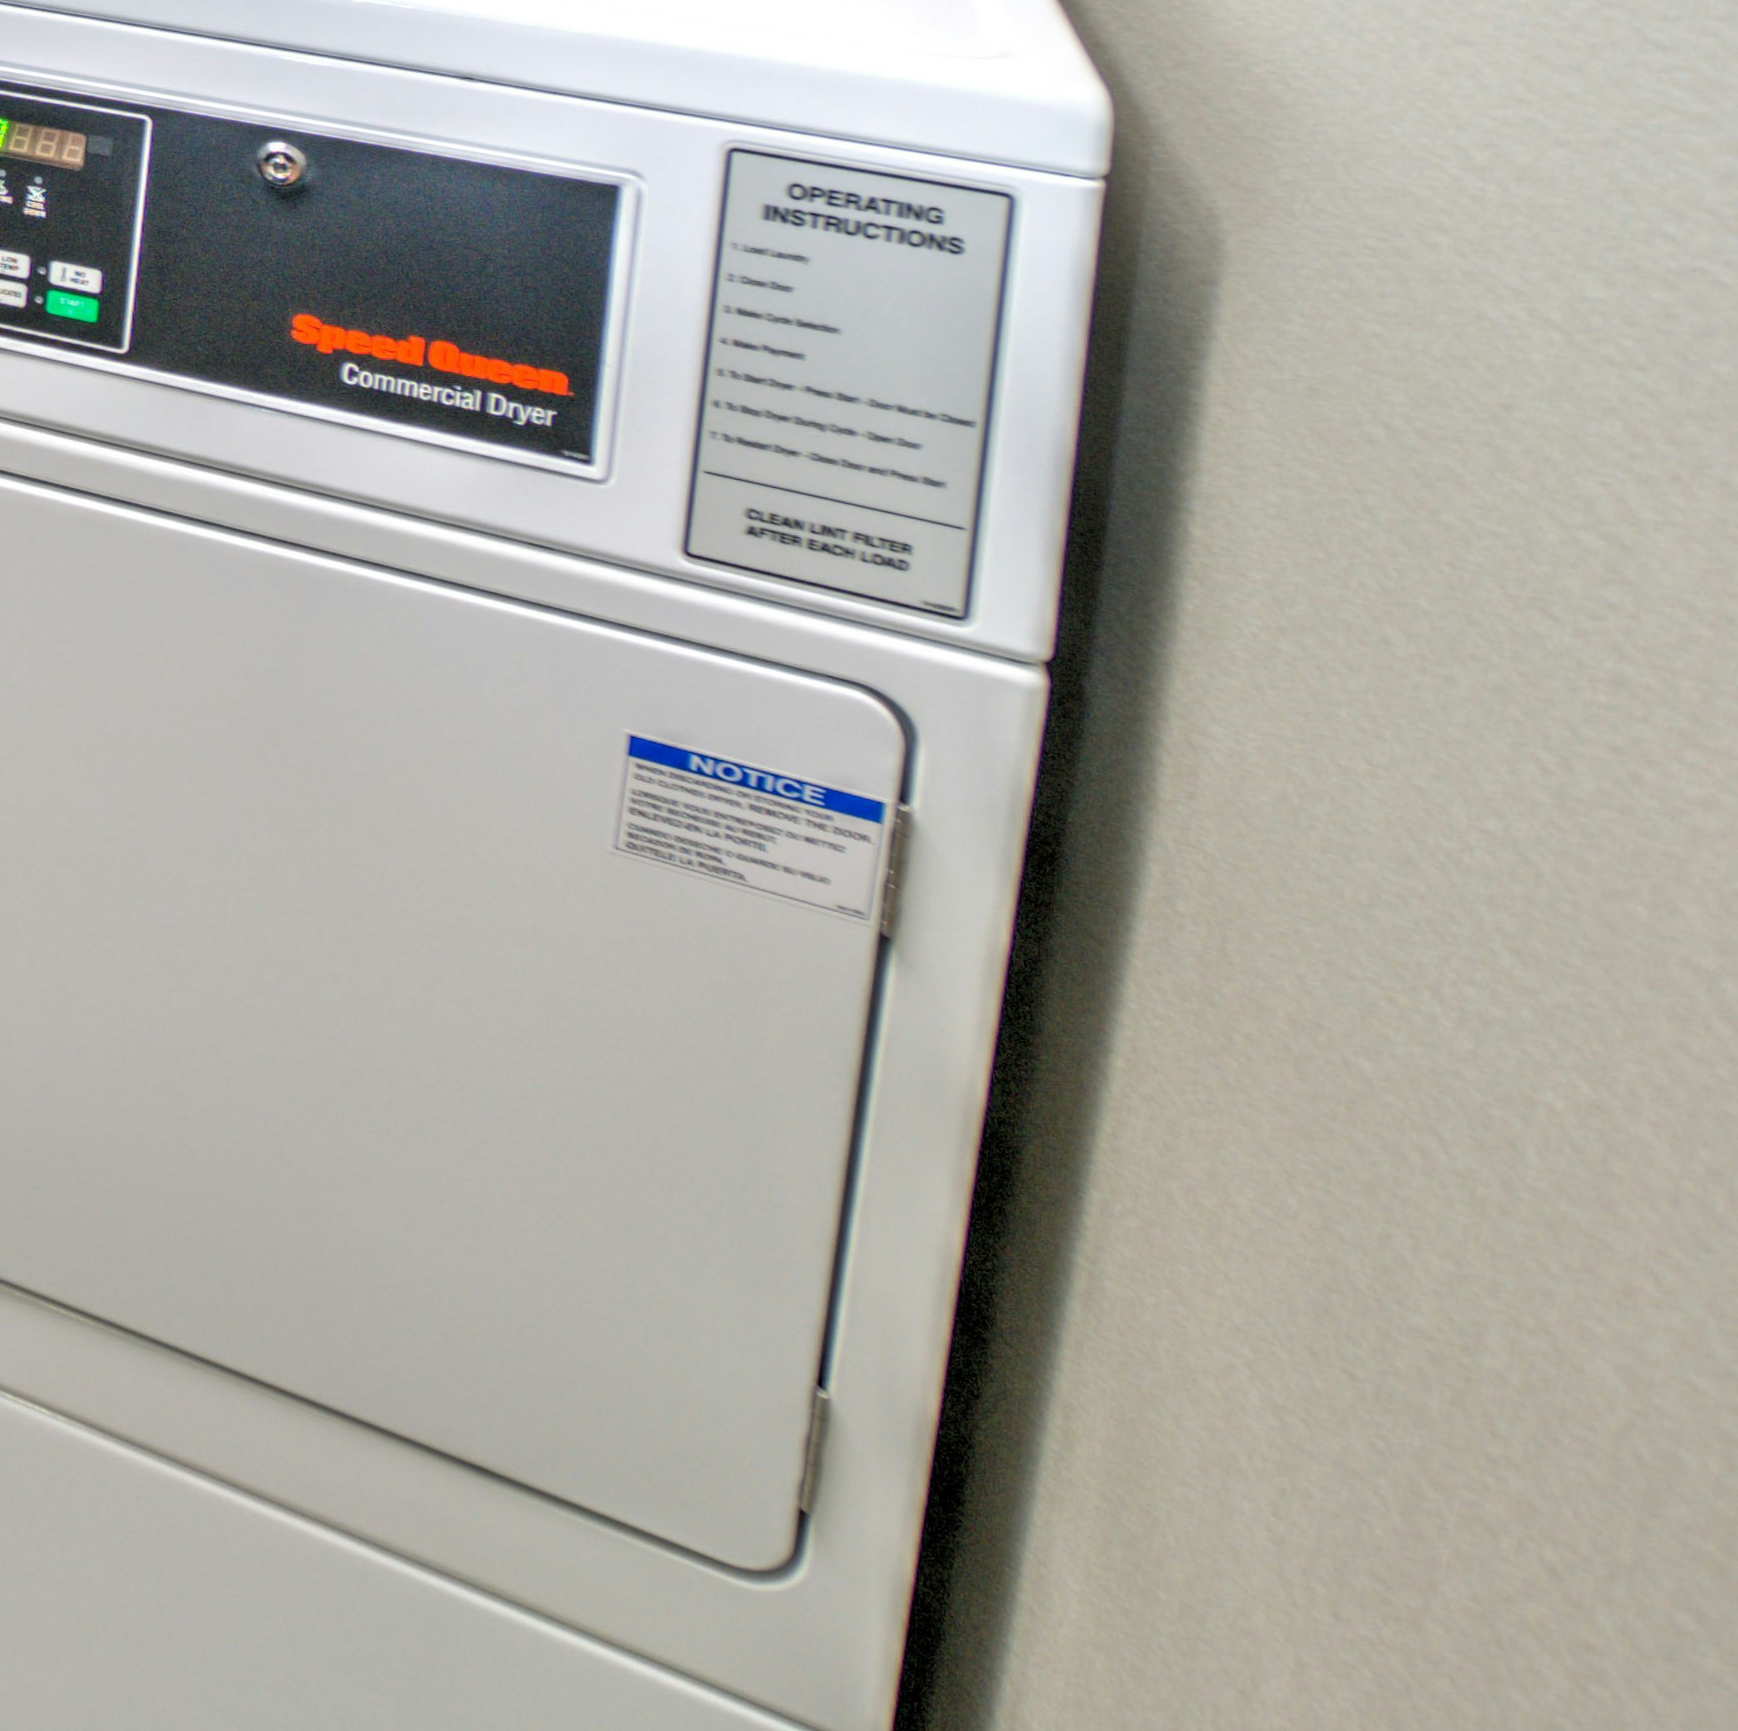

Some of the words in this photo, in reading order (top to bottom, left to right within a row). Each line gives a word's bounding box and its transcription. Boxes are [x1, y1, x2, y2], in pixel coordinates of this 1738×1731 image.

[763, 204, 965, 254] INSTRUCTIONS
[787, 183, 945, 225] OPERATING
[291, 313, 425, 366] Speed
[428, 340, 569, 396] Queen
[340, 362, 481, 411] Commercial
[487, 392, 557, 426] Dryer
[746, 508, 804, 531] CLEAN
[810, 525, 847, 540] LINT
[853, 533, 913, 555] FILTER
[746, 526, 802, 547] AFTER
[807, 539, 855, 559] EACH
[861, 551, 910, 571] LOAD
[689, 754, 826, 806] NOTICE
